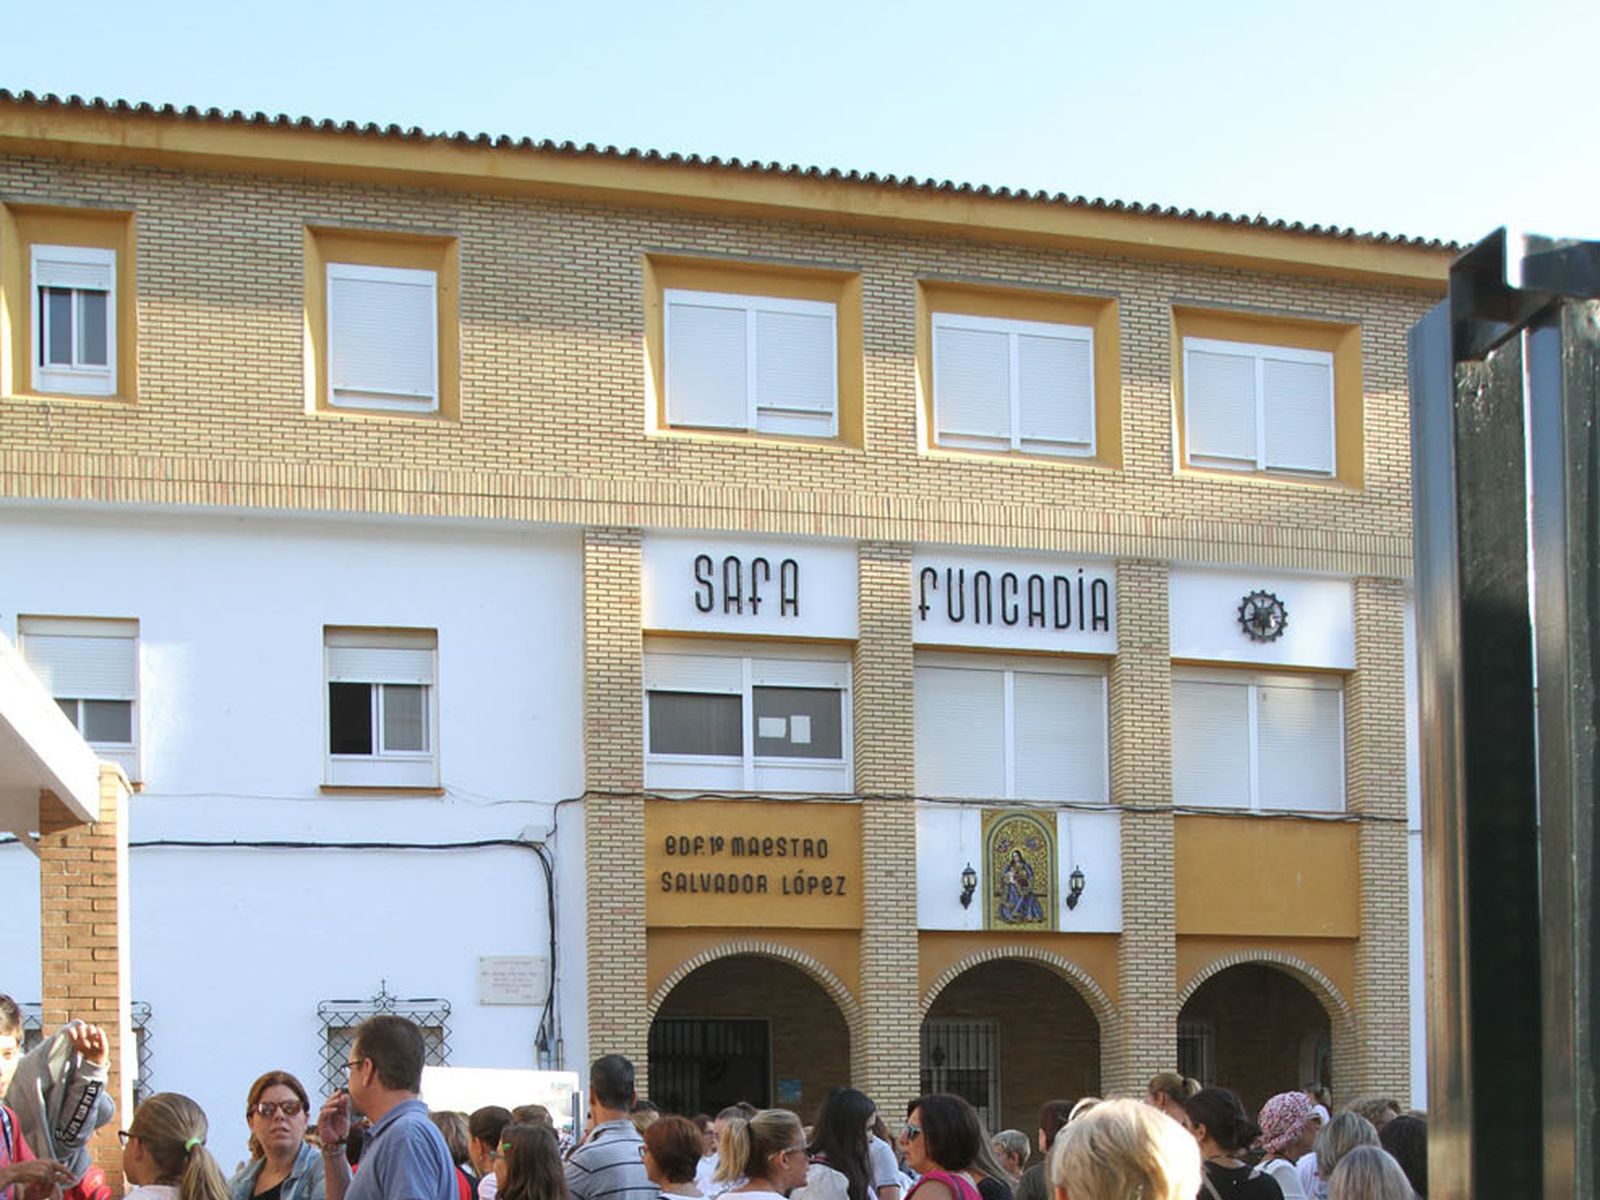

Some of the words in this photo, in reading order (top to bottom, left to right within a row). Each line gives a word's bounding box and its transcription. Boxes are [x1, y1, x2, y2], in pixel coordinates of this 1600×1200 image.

[694, 554, 799, 617] SAFA
[731, 836, 829, 859] MAESTRO
[661, 871, 768, 894] SALVADOR
[782, 868, 846, 896] LÓPEZ
